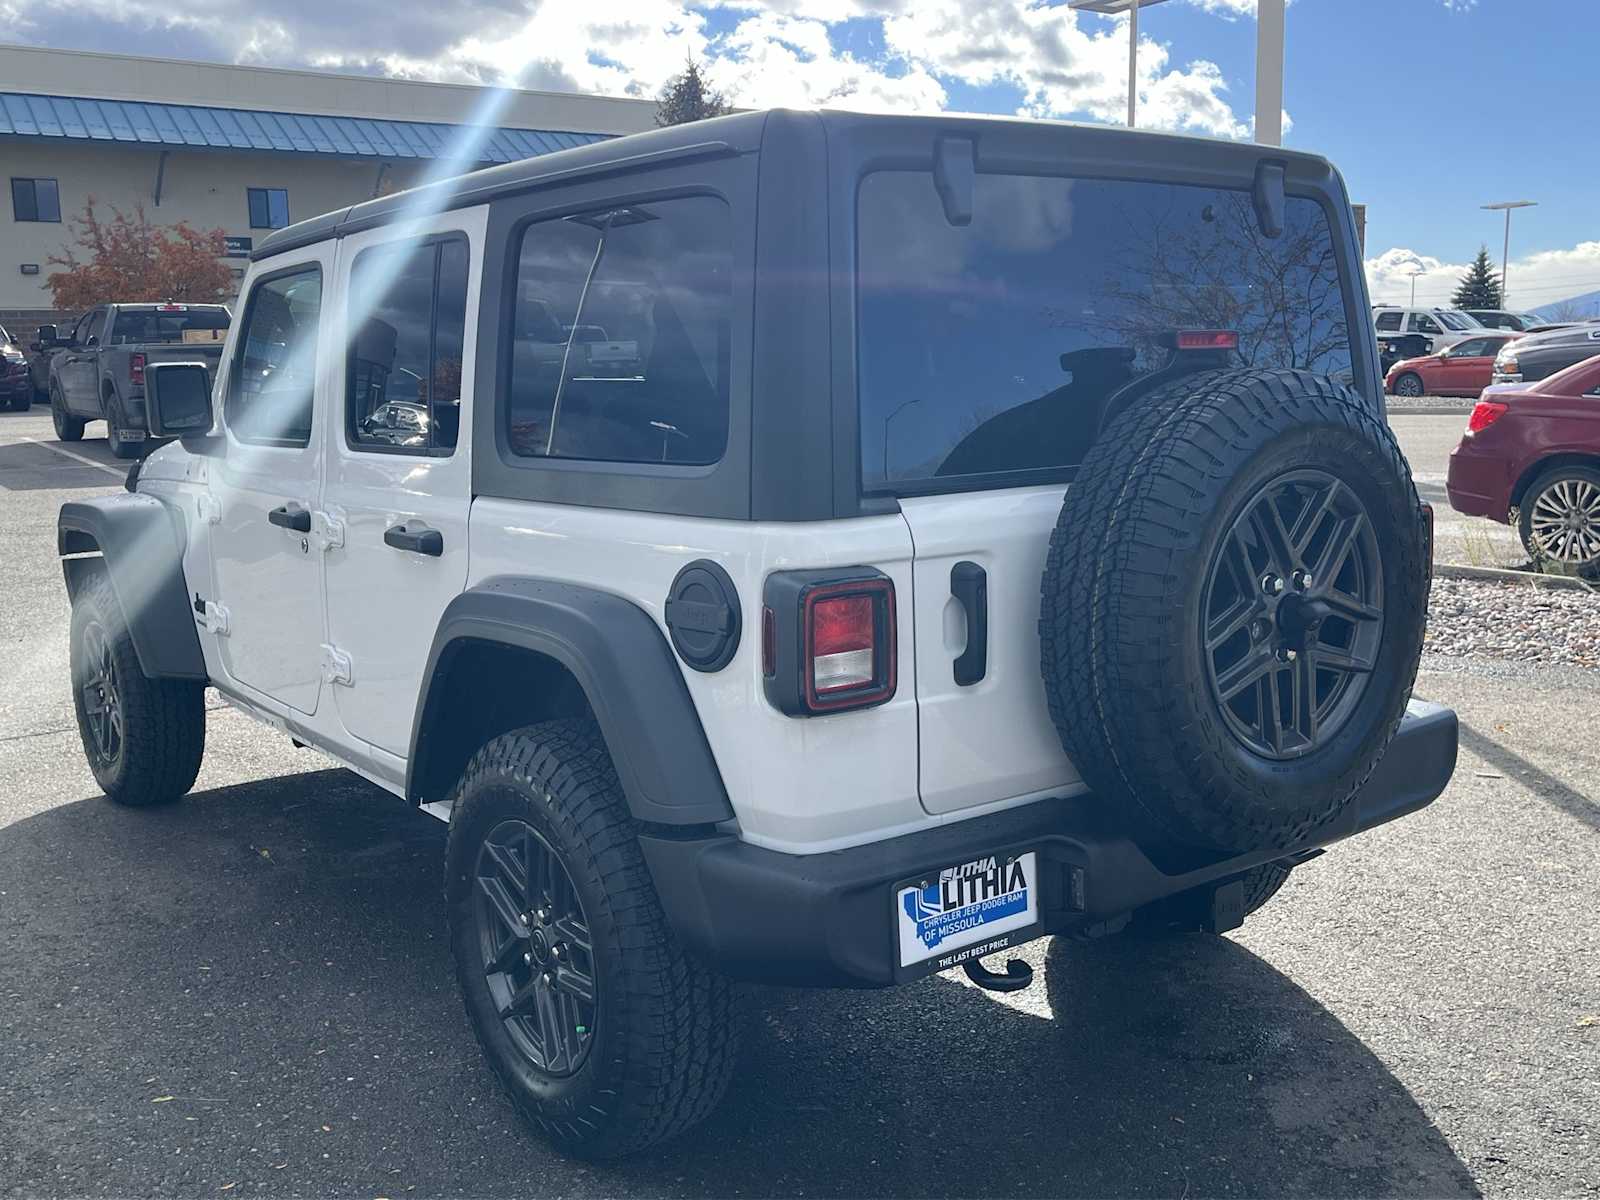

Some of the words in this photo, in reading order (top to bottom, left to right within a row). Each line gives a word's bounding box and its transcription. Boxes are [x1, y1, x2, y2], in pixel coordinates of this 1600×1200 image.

[952, 856, 996, 879] LITHIA
[943, 861, 1027, 912] LITHIA
[924, 911, 961, 929] CHRYSLER
[963, 904, 980, 917] JEEP
[982, 898, 1006, 911] DODGE
[1007, 892, 1023, 904] RAM
[924, 930, 936, 941] OF
[939, 915, 984, 937] MISSOULA
[939, 956, 952, 968] THE
[954, 950, 970, 963] LAST
[971, 944, 987, 957] BEST
[990, 938, 1008, 951] PRICE
